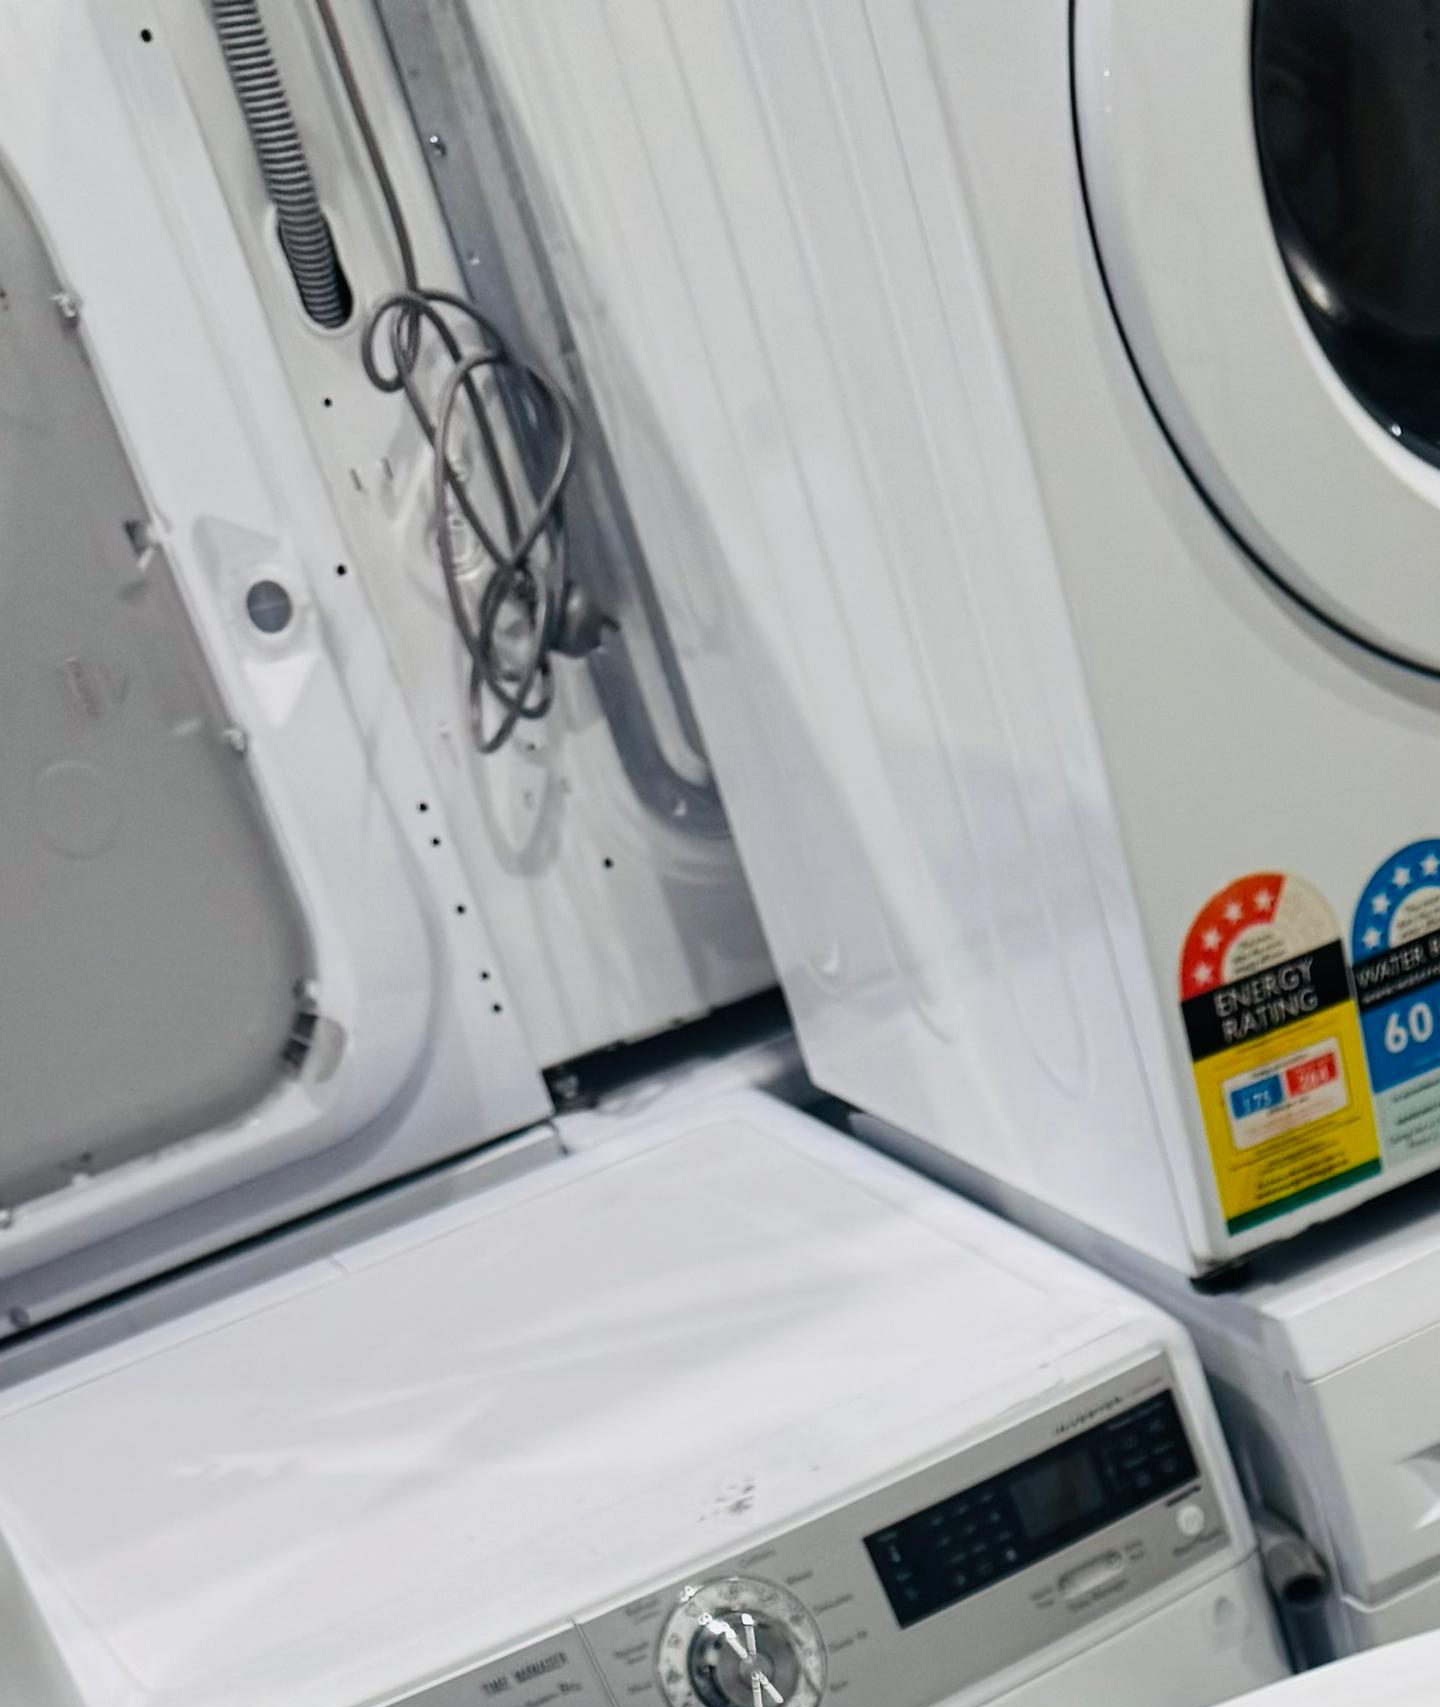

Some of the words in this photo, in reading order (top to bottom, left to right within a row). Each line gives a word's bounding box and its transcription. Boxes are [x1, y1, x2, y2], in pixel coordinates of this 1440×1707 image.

[1214, 956, 1314, 1018] ENERGY
[1357, 946, 1425, 988] WATER
[1221, 987, 1319, 1043] RATING
[1384, 1002, 1434, 1055] 60
